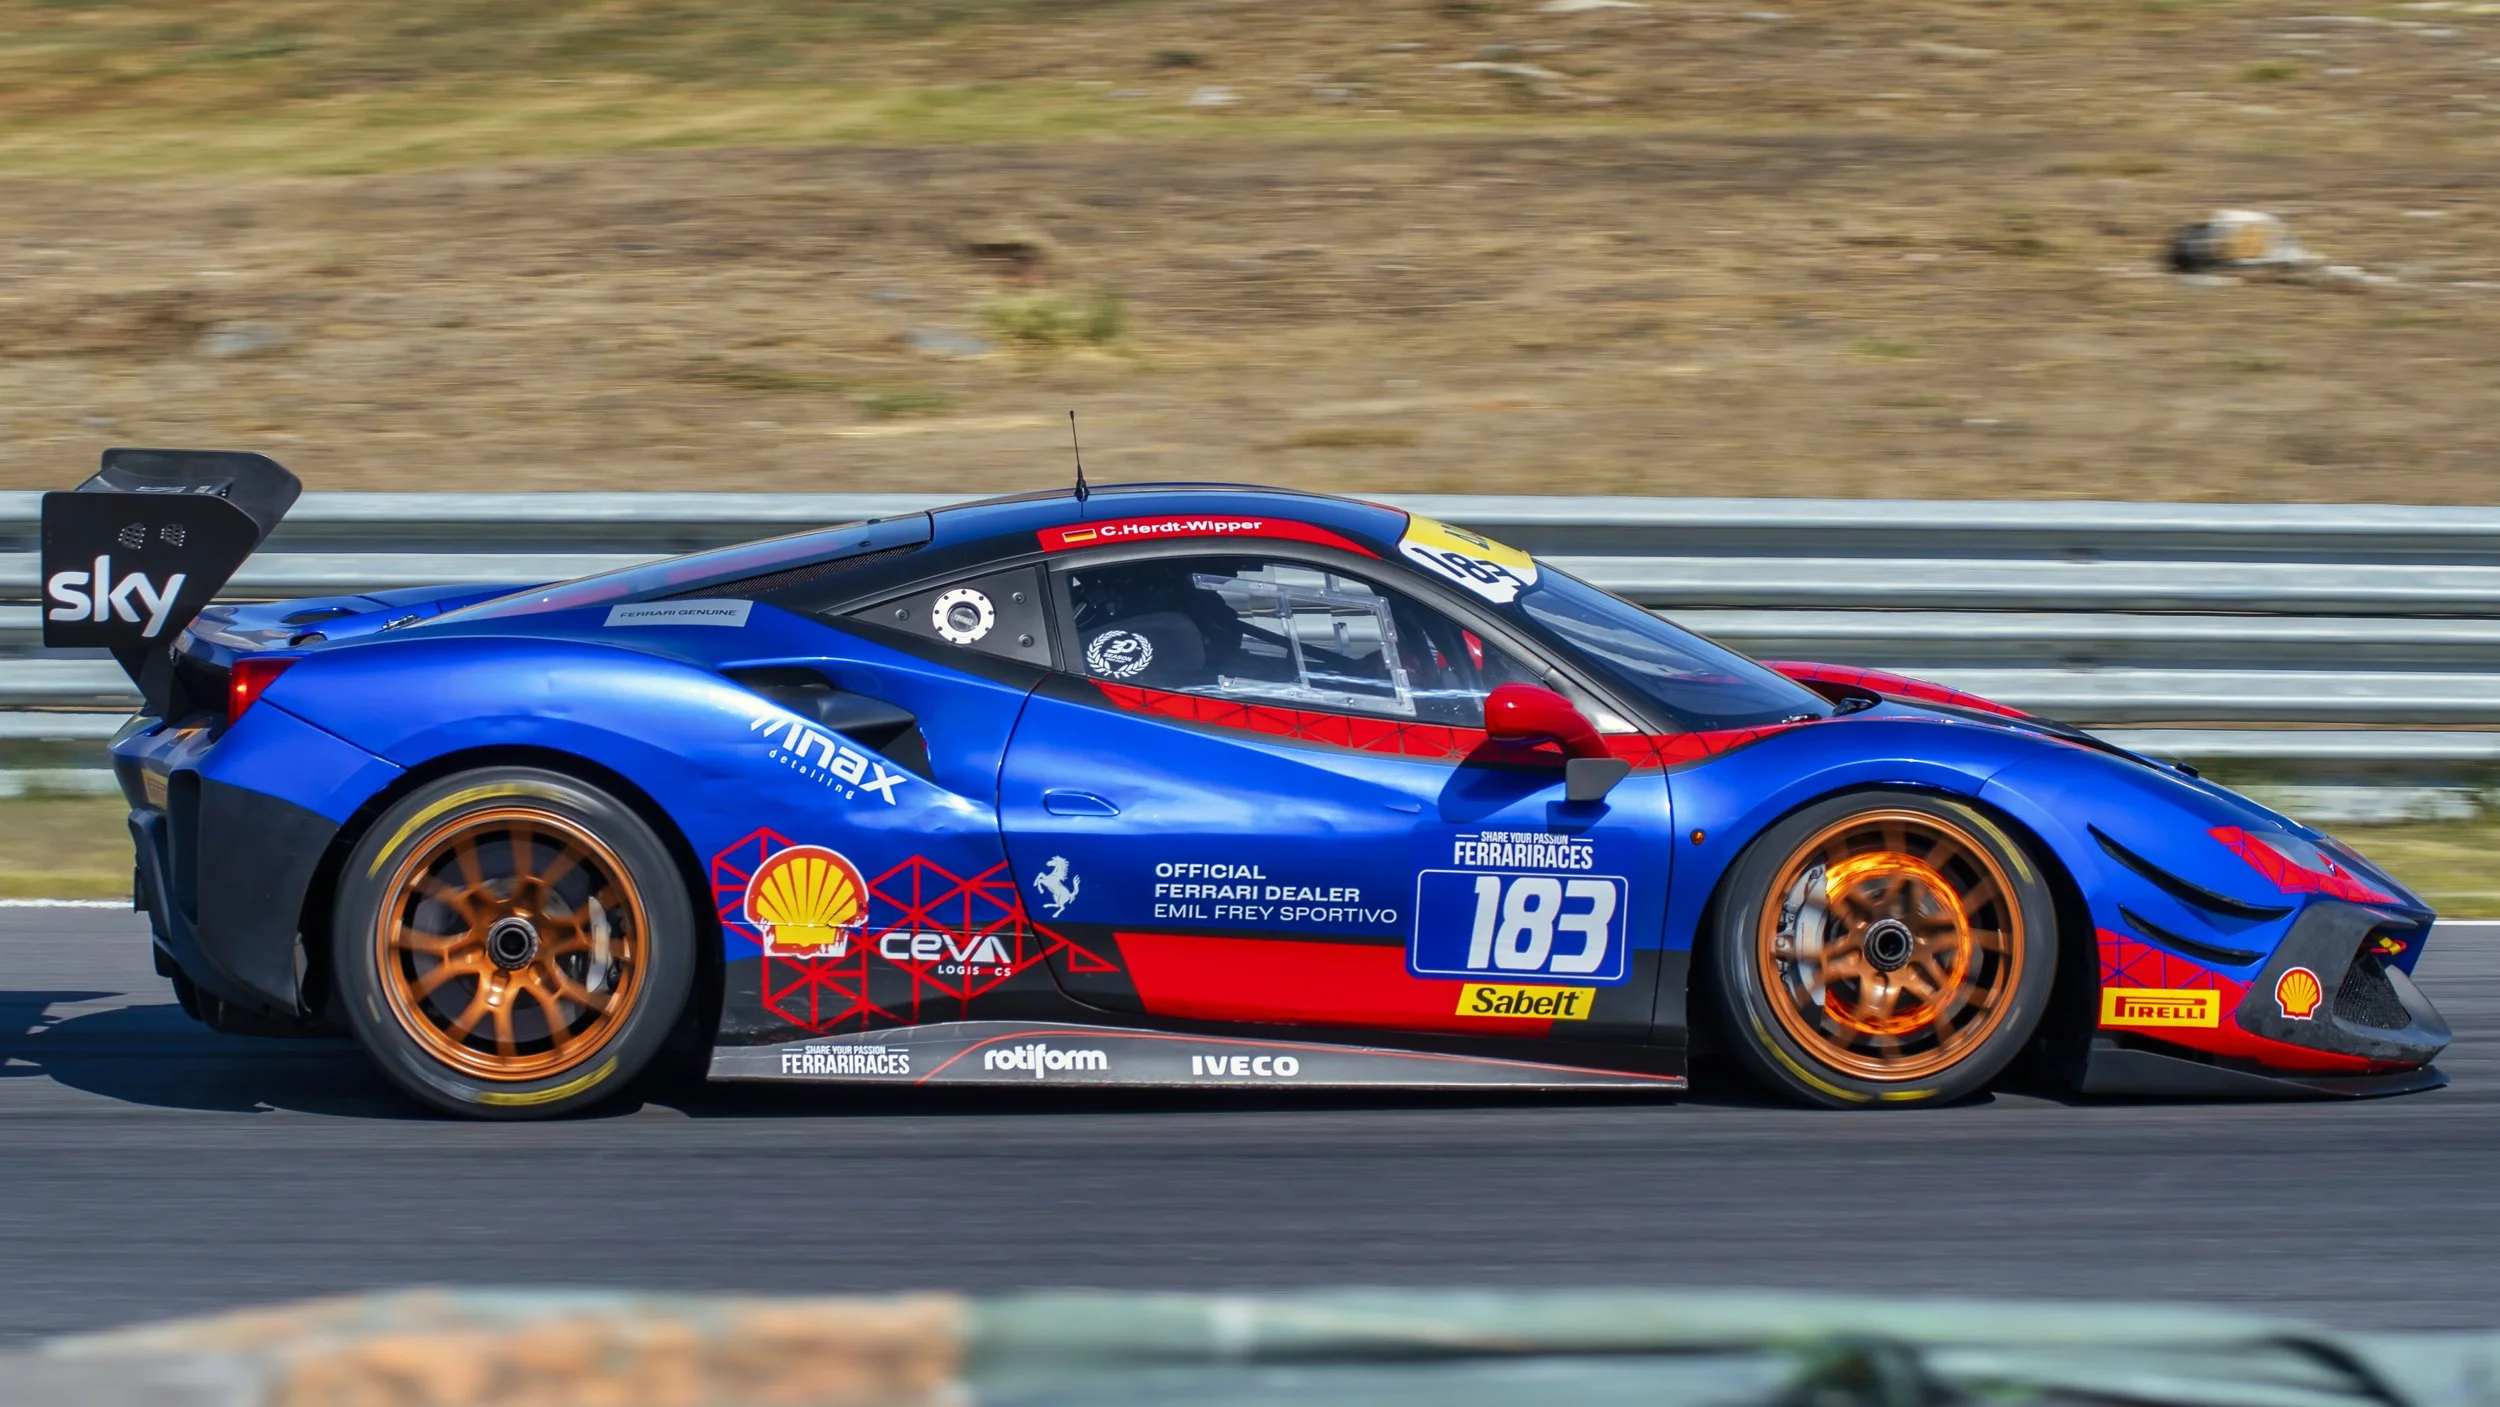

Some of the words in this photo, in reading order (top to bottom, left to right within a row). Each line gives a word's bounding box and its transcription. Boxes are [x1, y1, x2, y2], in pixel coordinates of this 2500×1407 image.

[1101, 520, 1263, 537] C.Herdt-Wipper
[48, 554, 187, 638] sky
[619, 609, 677, 619] FERRARI
[678, 608, 738, 617] GENUINE
[768, 748, 855, 800] detailing
[1480, 831, 1509, 843] SHARE
[1510, 832, 1532, 844] YOUR
[1533, 833, 1569, 845] PASSION
[1454, 841, 1594, 870] FERRARIRACES
[1155, 863, 1267, 880] OFFICIAL
[1154, 883, 1259, 901] FERRARI
[1265, 887, 1360, 903] DEALER
[1154, 903, 1208, 919] EMIL
[1215, 905, 1275, 921] FREY
[1279, 906, 1398, 924] SPORTIVO
[1467, 876, 1617, 974] 183
[1471, 987, 1580, 1017] Sabelt
[2114, 996, 2208, 1020] PIRELLI
[805, 1045, 831, 1055] SHARE
[832, 1046, 853, 1055] YOUR
[853, 1046, 886, 1055] PASSION
[782, 1054, 911, 1075] FERRARIRACES
[984, 1043, 1108, 1079] rotiform
[1191, 1055, 1300, 1077] IVECO
